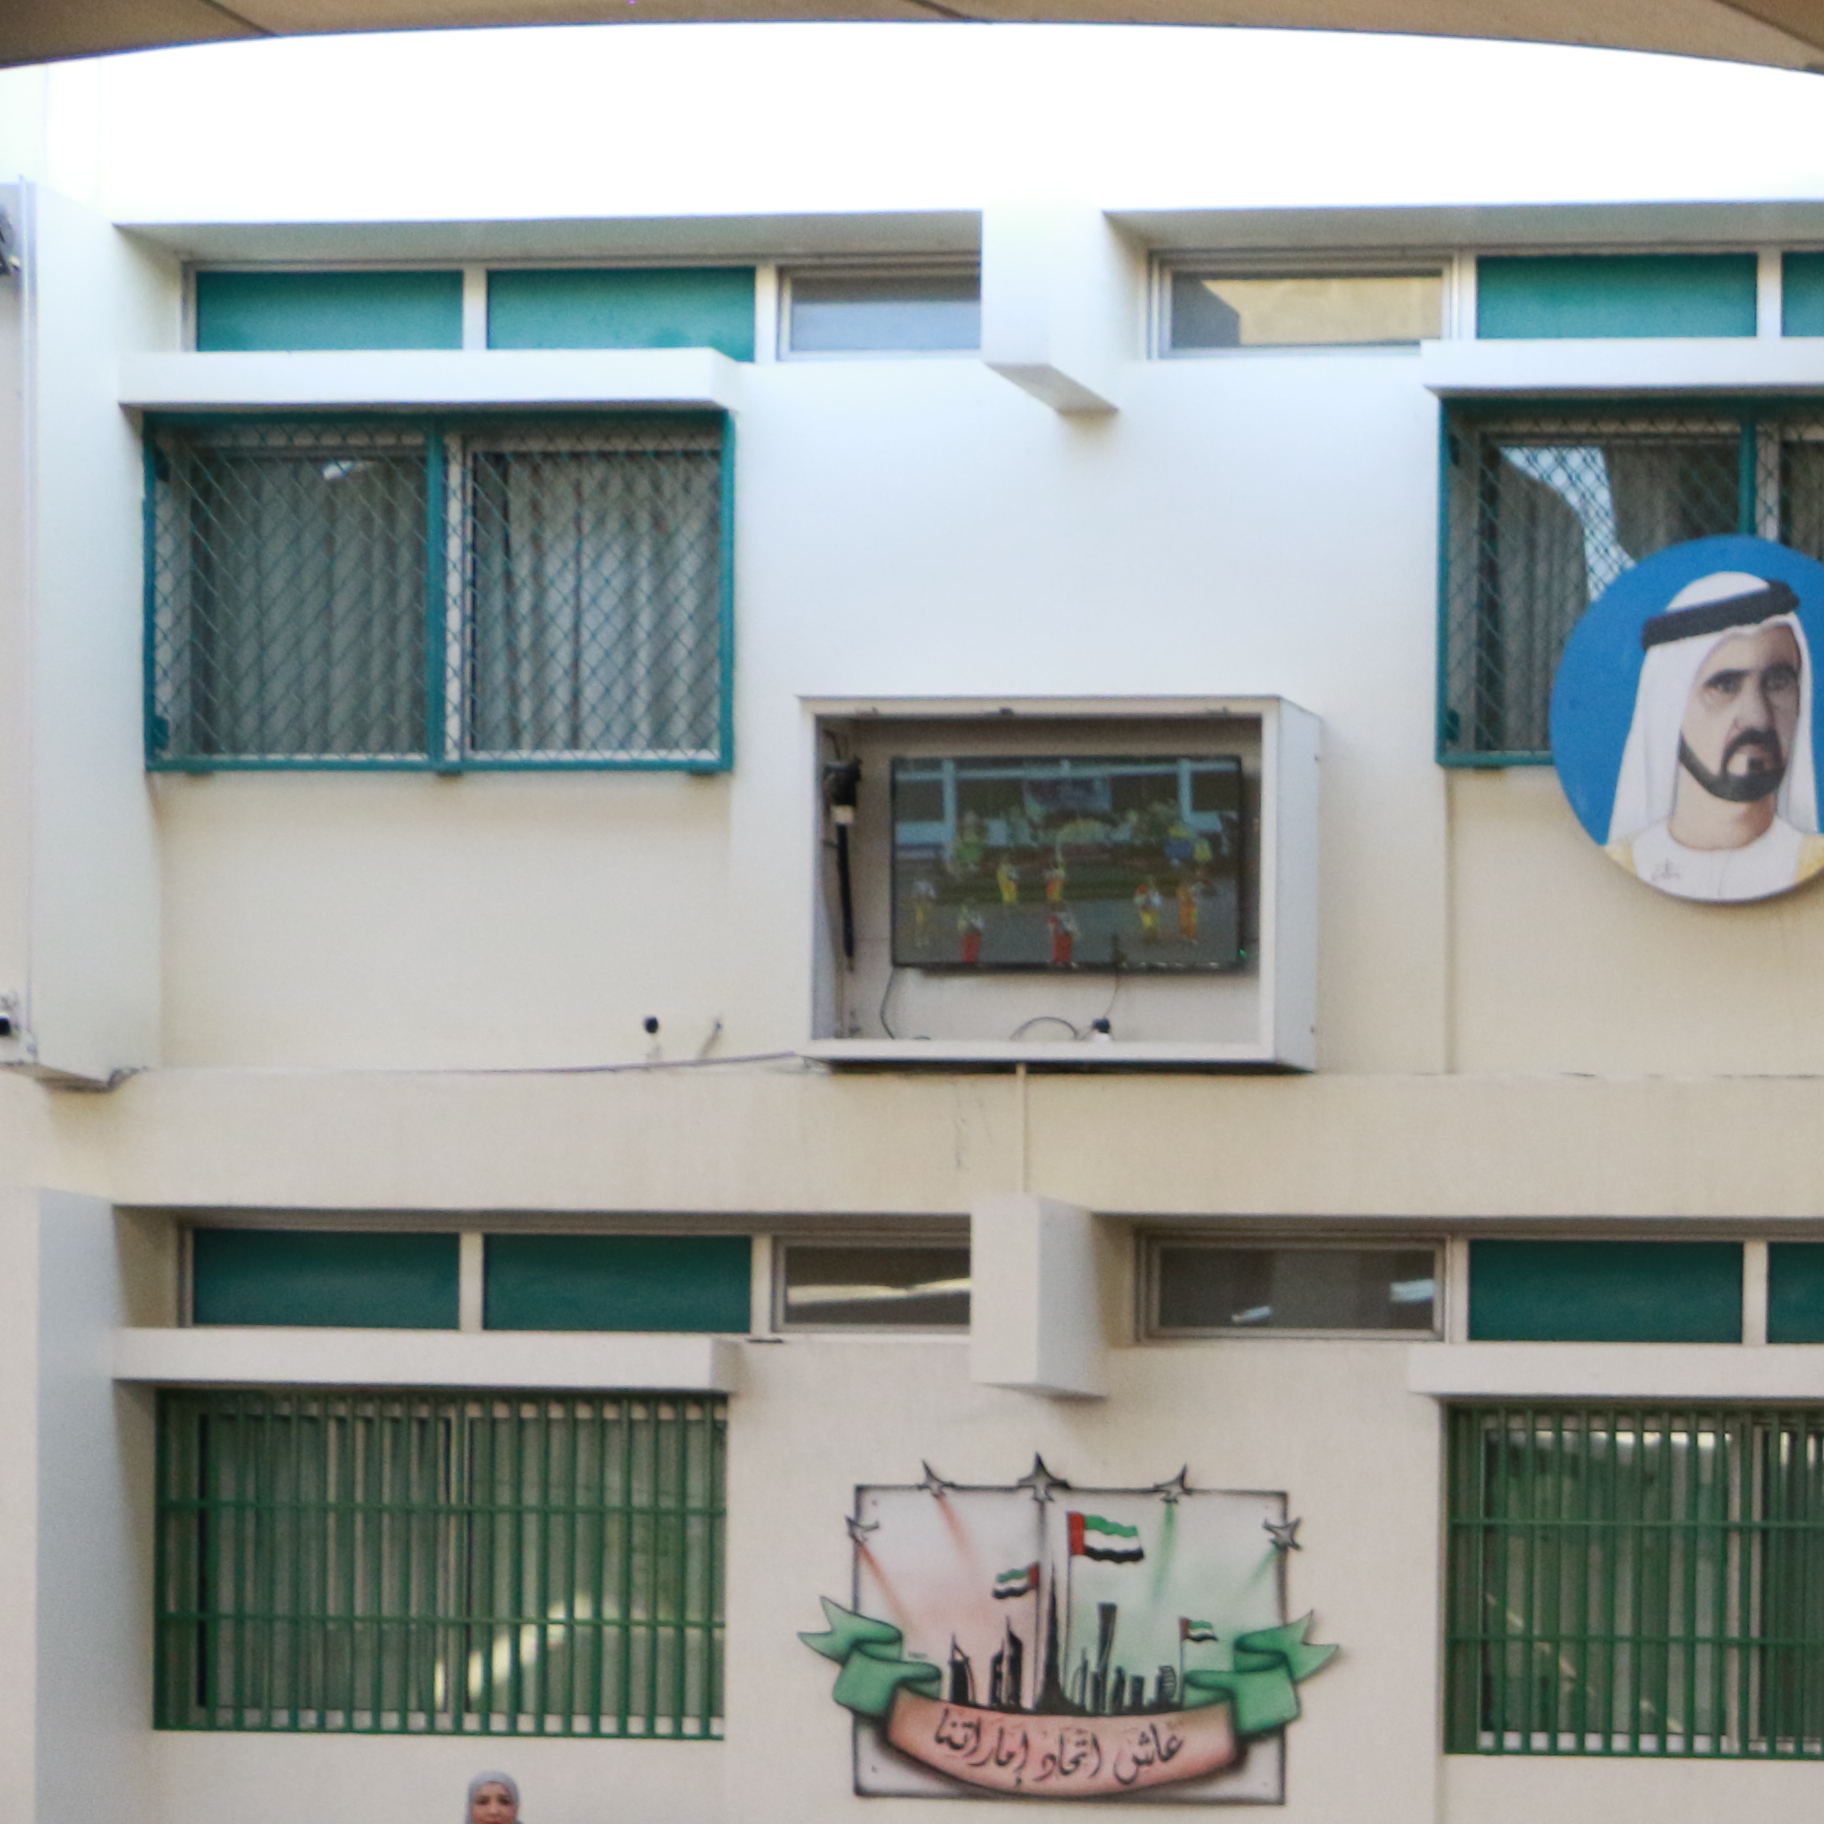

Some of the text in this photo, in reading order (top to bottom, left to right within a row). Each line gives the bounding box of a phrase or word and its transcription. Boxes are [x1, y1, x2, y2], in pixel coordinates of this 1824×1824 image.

[934, 1706, 1184, 1787] عاش اتحاد إماراتنا
